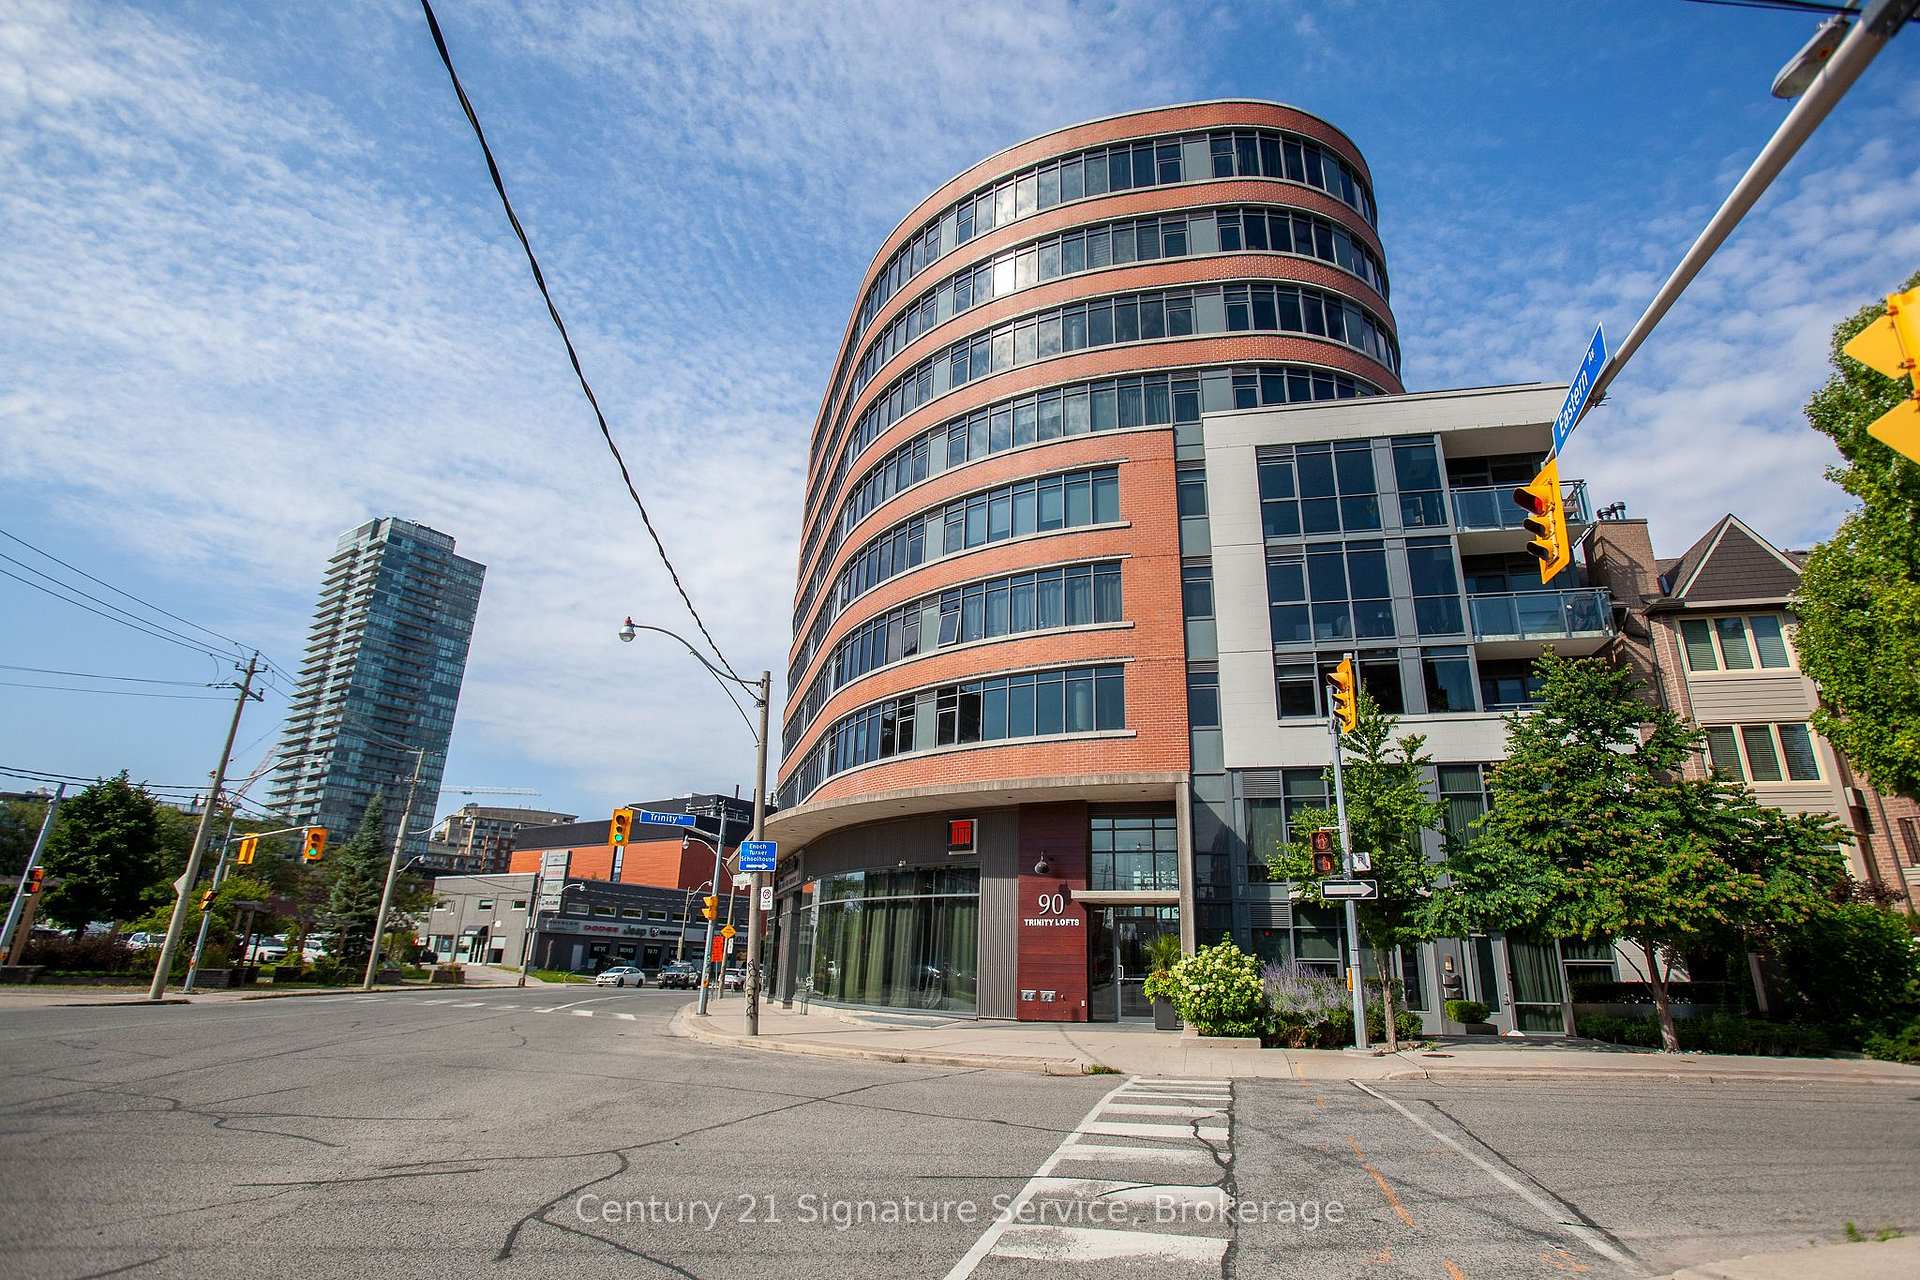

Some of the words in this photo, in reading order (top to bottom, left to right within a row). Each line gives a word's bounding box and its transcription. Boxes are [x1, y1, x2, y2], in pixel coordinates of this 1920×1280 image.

[1559, 370, 1588, 437] Eastern
[650, 813, 677, 824] Trinity
[1038, 894, 1064, 915] 90
[1023, 918, 1054, 927] TRINITY
[1054, 918, 1080, 927] LOFTS
[583, 924, 620, 933] DODGE
[623, 925, 647, 937] Jeep
